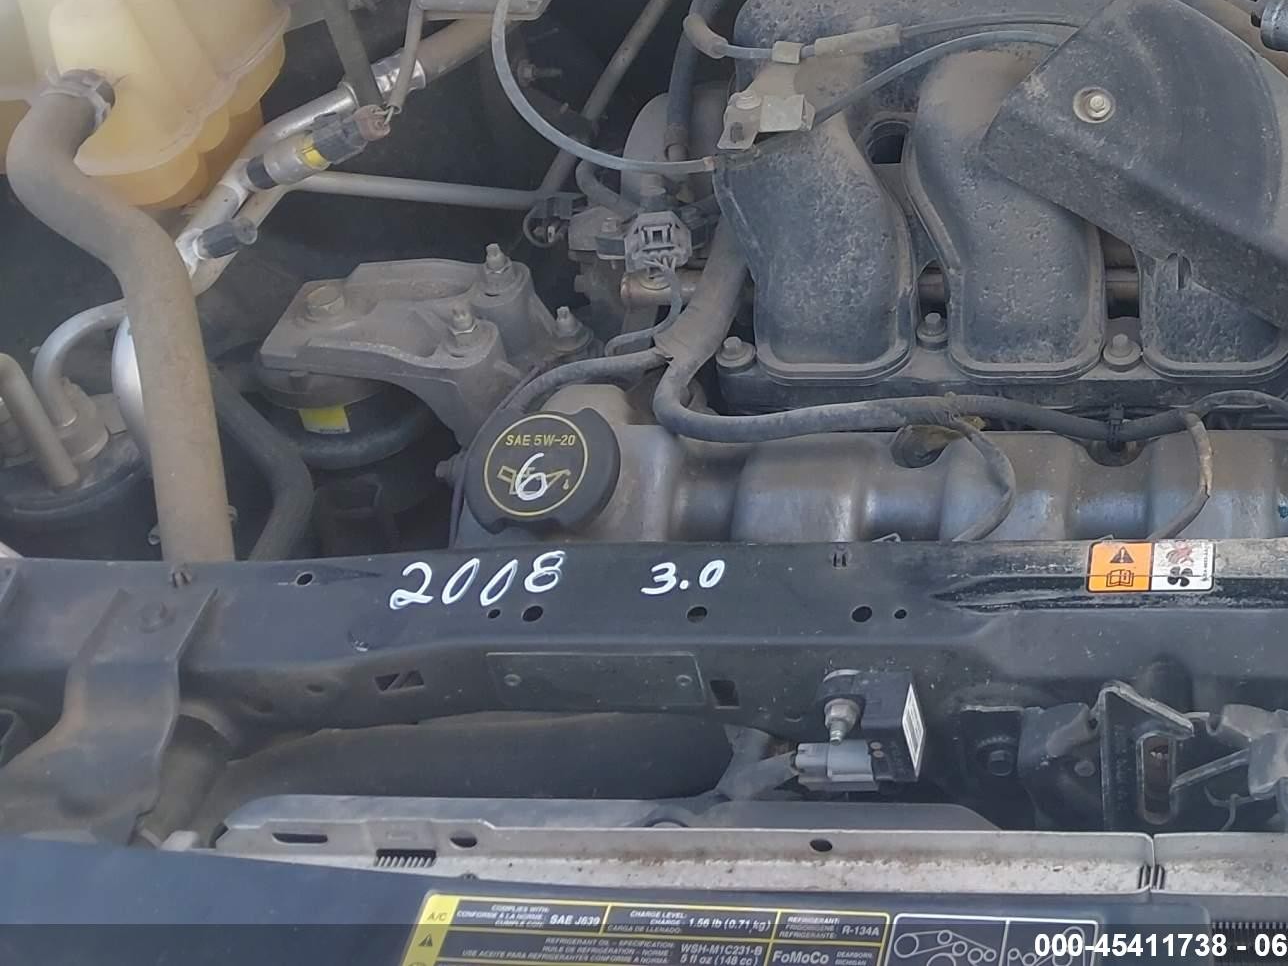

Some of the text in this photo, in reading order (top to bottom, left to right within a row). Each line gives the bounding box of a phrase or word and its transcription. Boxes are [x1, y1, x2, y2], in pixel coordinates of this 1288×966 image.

[505, 434, 576, 446] SAE 5W-20
[514, 452, 548, 501] 6
[389, 550, 726, 610] 2008 3.0
[426, 911, 447, 922] A/C
[550, 913, 574, 925] SAE
[752, 918, 772, 933] kg)
[841, 924, 880, 936] R-134A
[680, 942, 763, 956] WSH-M1C231-B
[699, 955, 713, 965] oz
[772, 950, 830, 965] FoMoCo
